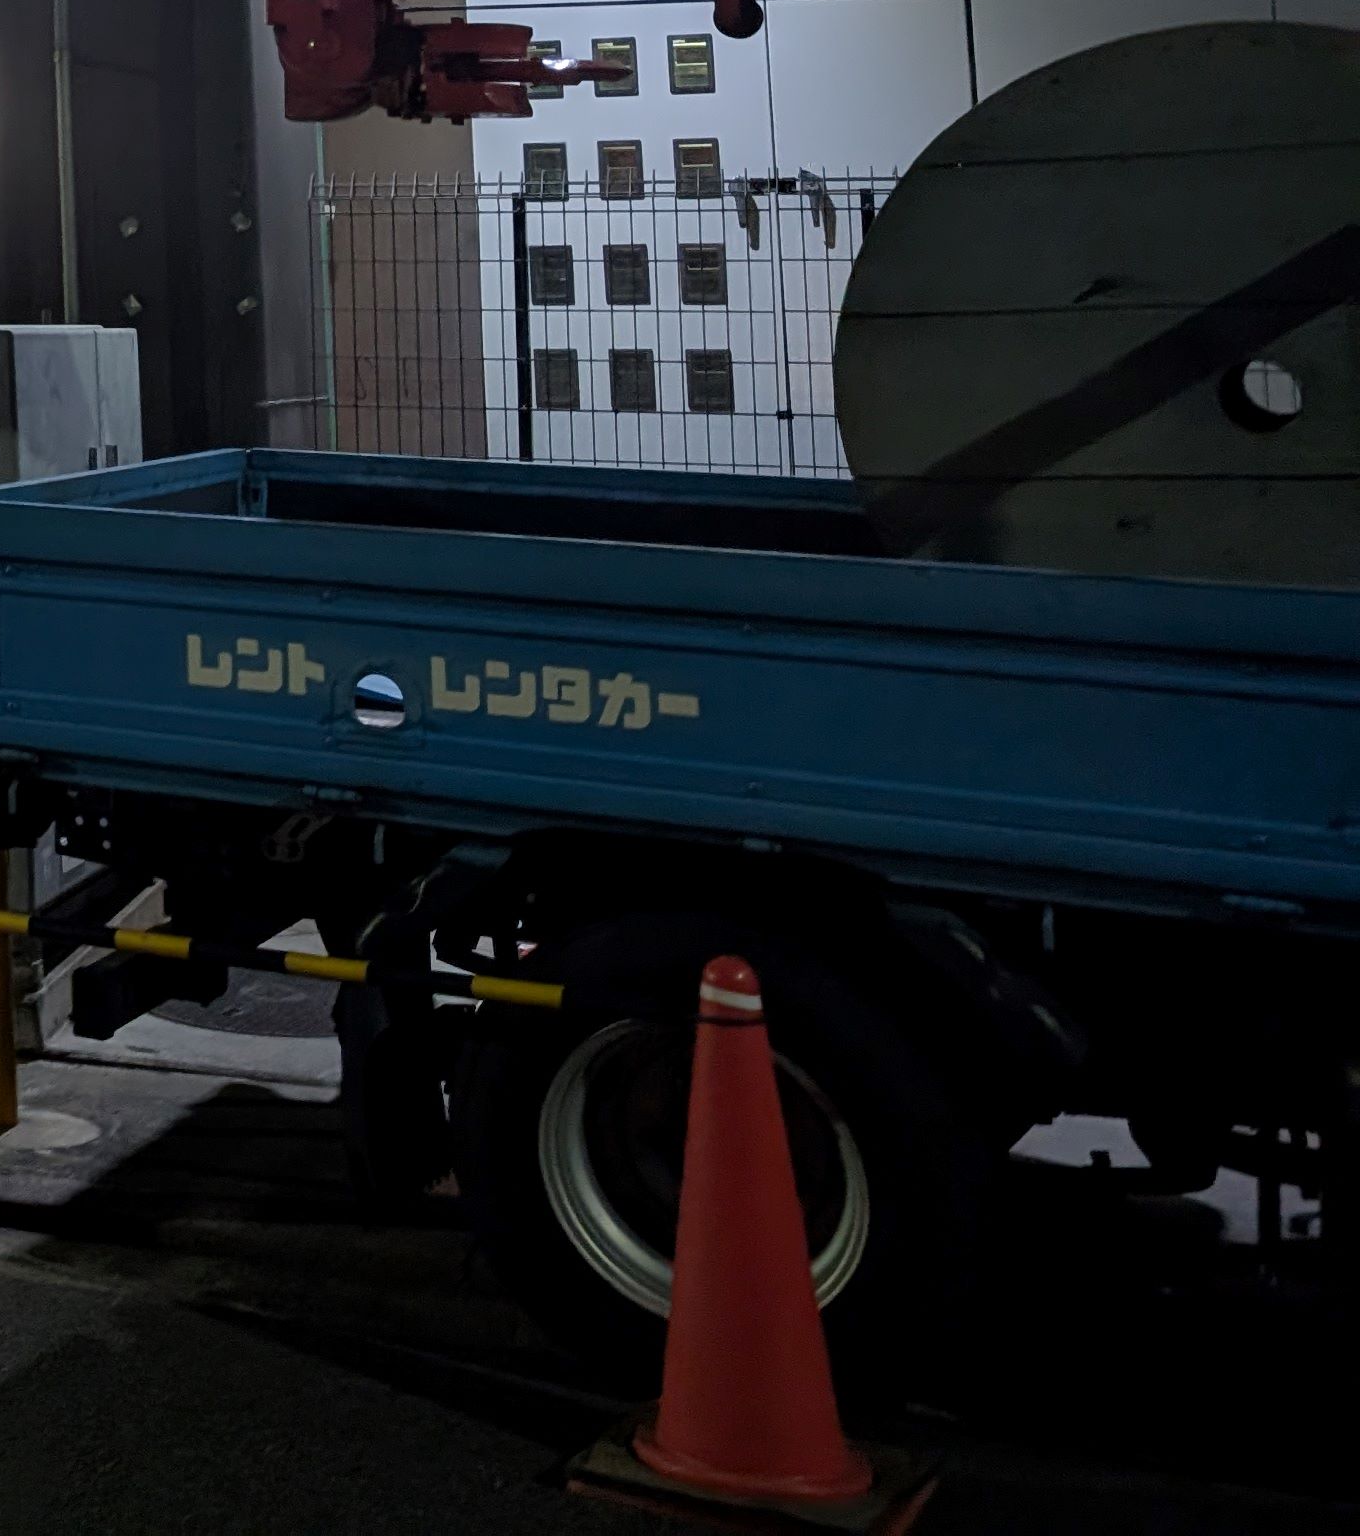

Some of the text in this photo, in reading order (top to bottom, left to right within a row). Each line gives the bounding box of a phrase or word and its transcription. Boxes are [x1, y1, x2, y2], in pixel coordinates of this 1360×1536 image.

[186, 633, 700, 731] レント レンタカー
